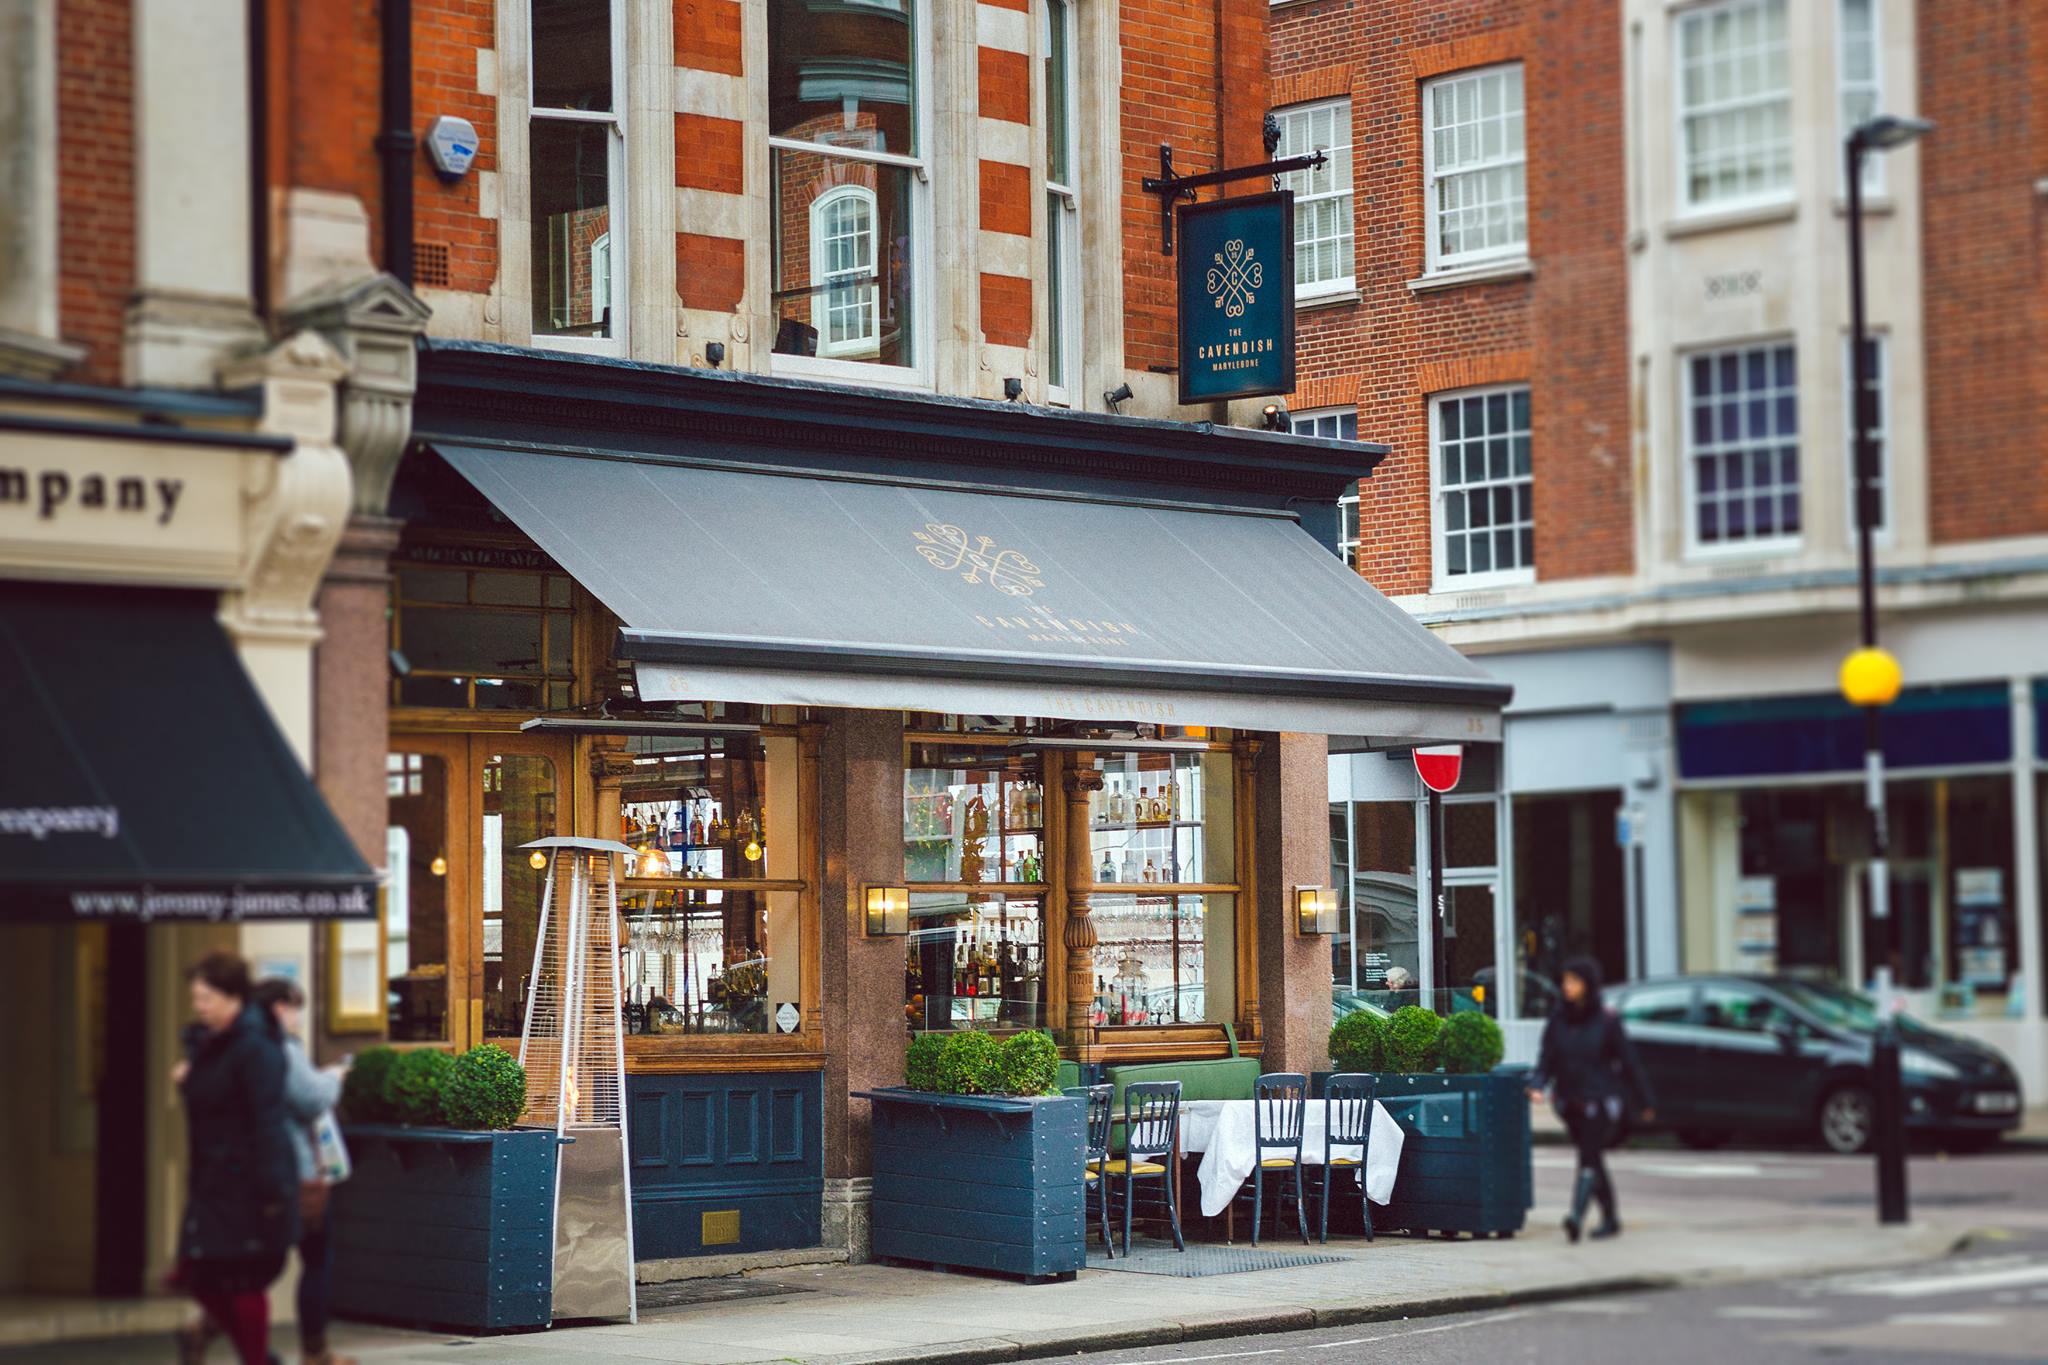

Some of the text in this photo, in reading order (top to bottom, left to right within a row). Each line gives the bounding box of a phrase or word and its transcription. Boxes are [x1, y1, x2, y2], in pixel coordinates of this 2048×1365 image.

[1228, 327, 1242, 337] THE
[1199, 338, 1273, 359] CAVENDISH
[1212, 358, 1259, 371] MARYLEBONE
[975, 614, 1139, 635] CAVENDISH
[1083, 697, 1176, 717] CAVENDISH
